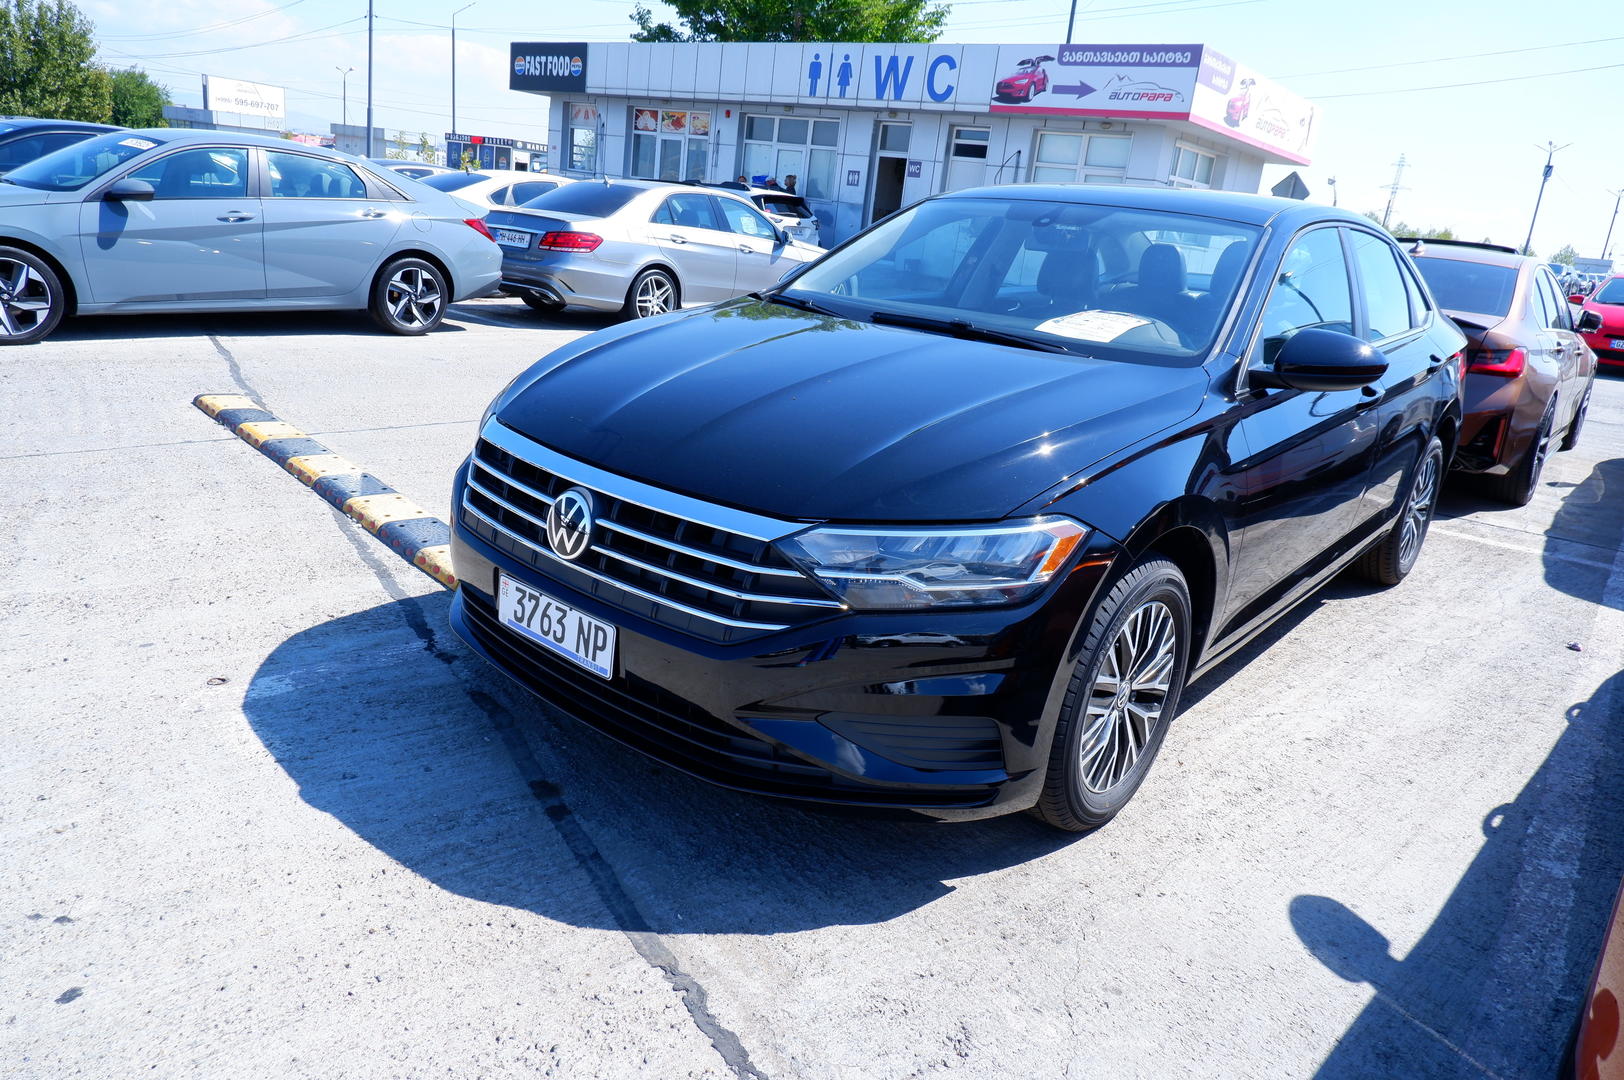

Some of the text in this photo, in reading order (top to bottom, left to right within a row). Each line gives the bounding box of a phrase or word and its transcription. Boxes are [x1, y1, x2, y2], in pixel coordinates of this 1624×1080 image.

[1142, 52, 1191, 63] საიტზე
[525, 55, 570, 76] FAST FOOD
[875, 55, 957, 103] WC
[234, 97, 280, 111] 595-697-707
[526, 143, 548, 152] MARKE
[909, 164, 921, 174] WC
[501, 588, 509, 598] GE
[514, 586, 608, 662] 3763 NP
